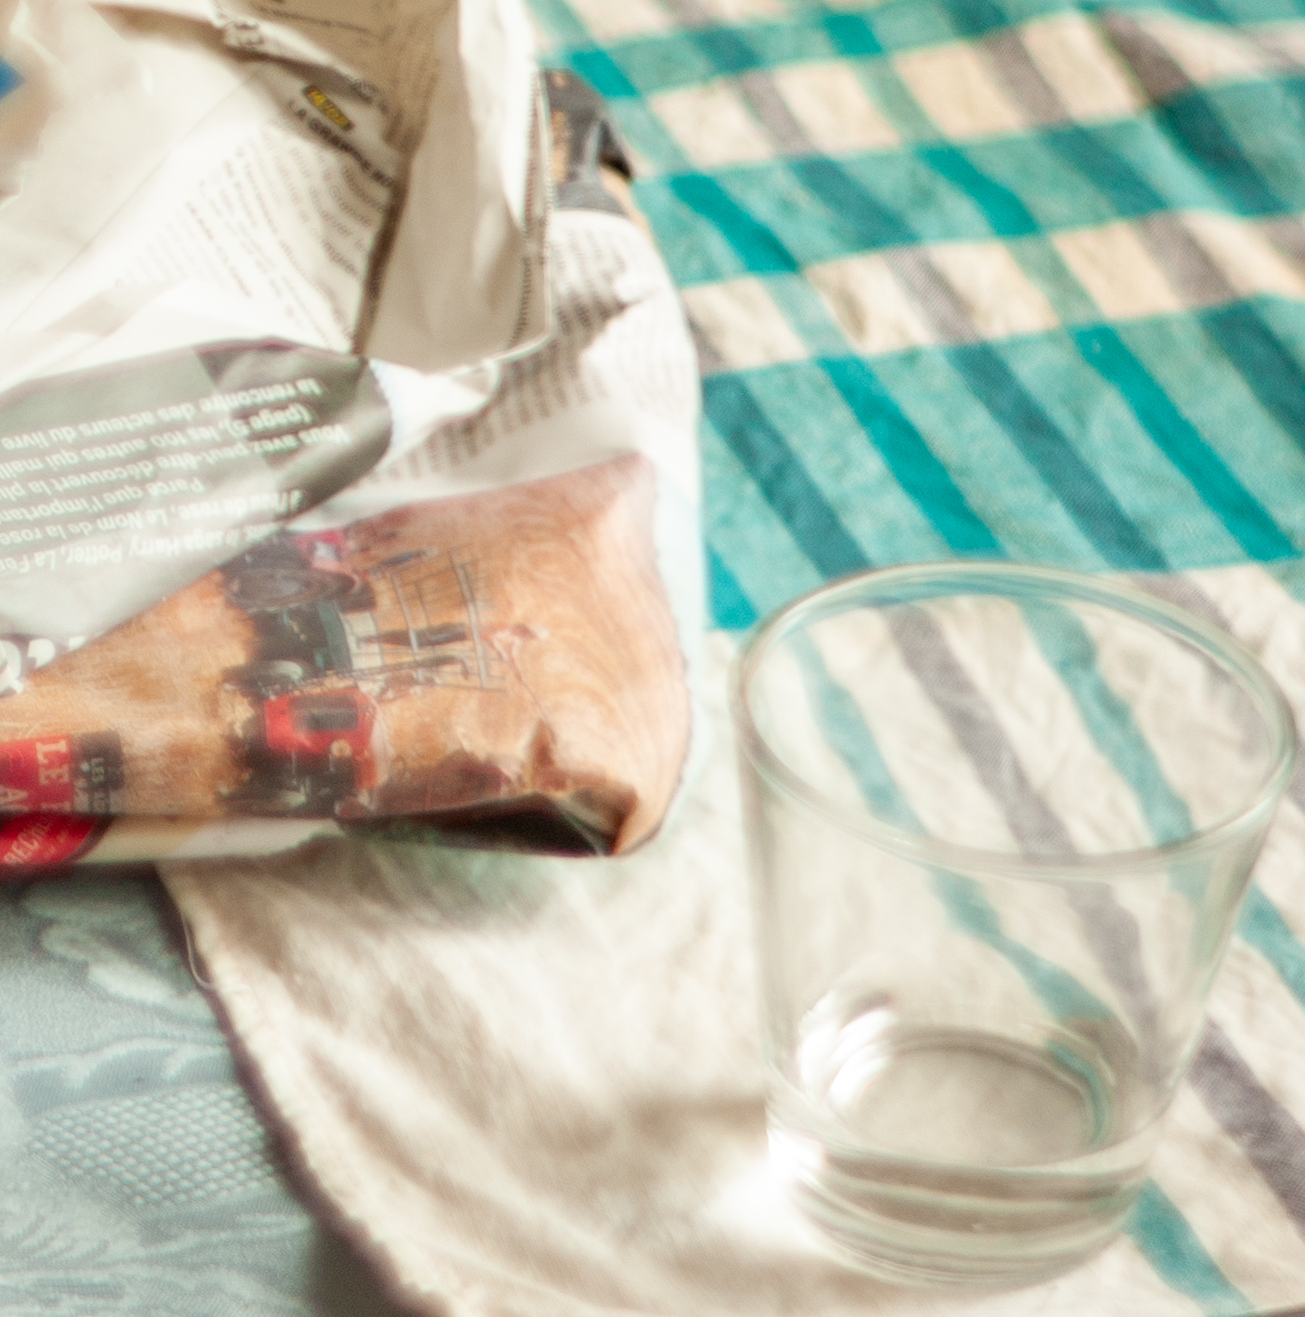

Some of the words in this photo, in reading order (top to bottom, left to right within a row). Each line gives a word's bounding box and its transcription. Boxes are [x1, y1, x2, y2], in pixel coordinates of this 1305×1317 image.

[196, 380, 295, 418] rencontre
[293, 375, 321, 397] la
[76, 408, 154, 441] acteurs
[156, 401, 194, 425] des
[246, 400, 311, 432] (page
[2, 429, 48, 455] livre
[49, 425, 75, 445] du
[149, 429, 185, 450] 100
[187, 423, 218, 444] les
[253, 433, 297, 457] avez
[44, 444, 78, 471] qui
[79, 435, 148, 464] autres
[154, 436, 249, 473] peut-être
[27, 479, 49, 499] la
[50, 458, 154, 494] découvert
[145, 473, 204, 500] Parce
[102, 481, 143, 506] que
[144, 506, 169, 528] Le
[170, 496, 220, 522] rose,
[44, 523, 63, 542] la
[67, 519, 93, 539] de
[96, 510, 145, 536] Nom
[58, 536, 122, 569] Potter,
[123, 527, 179, 561] Harry
[32, 548, 57, 569] La
[32, 736, 73, 787] LE
